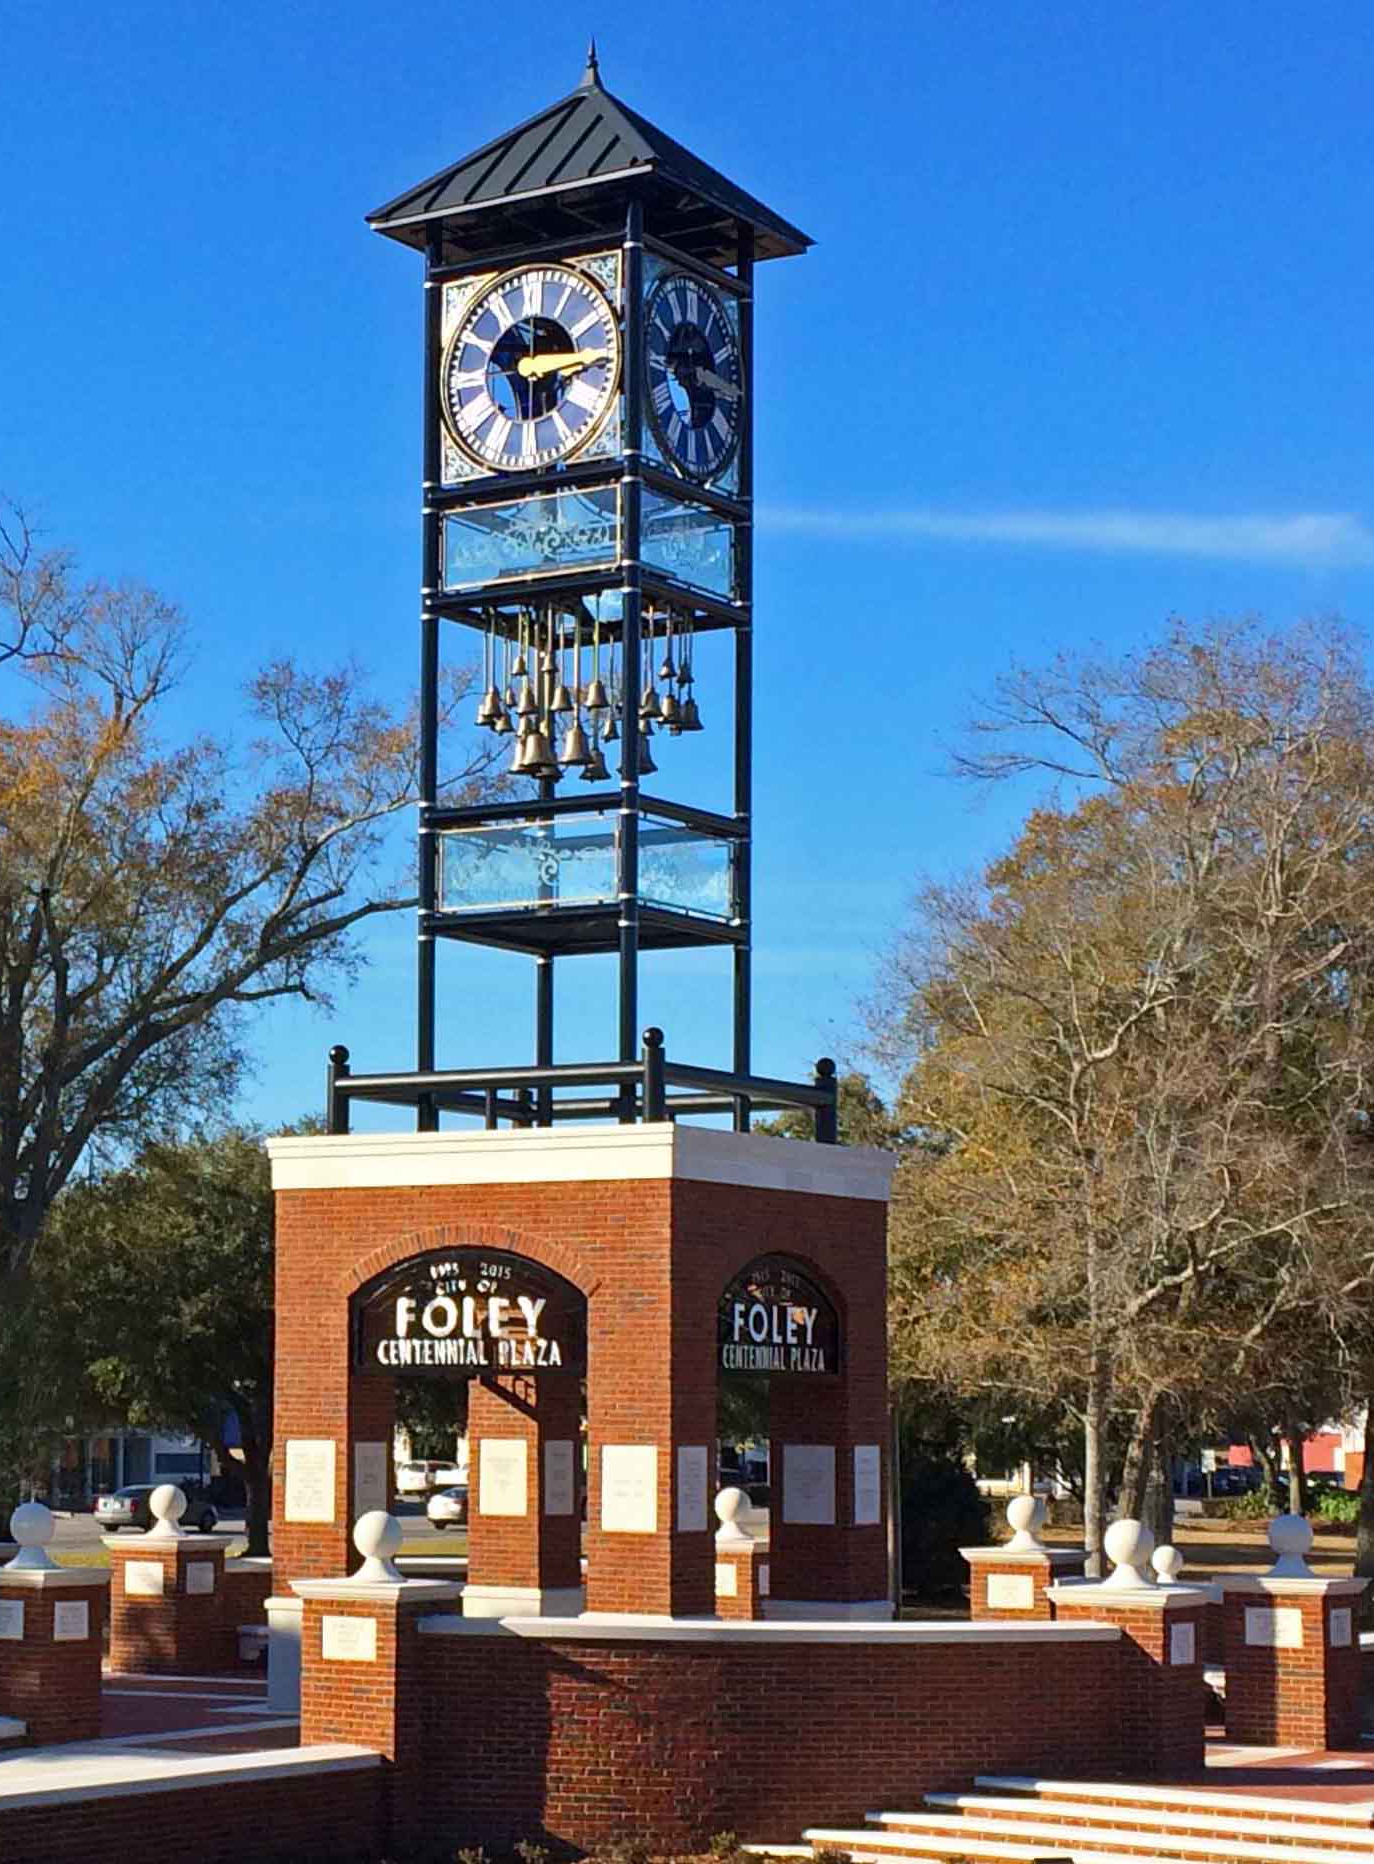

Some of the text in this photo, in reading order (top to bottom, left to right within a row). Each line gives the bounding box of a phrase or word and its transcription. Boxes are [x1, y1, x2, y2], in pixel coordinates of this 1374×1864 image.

[479, 1261, 513, 1280] 2015
[395, 1296, 546, 1338] FOLEY
[733, 1303, 818, 1344] FOLEY
[377, 1340, 562, 1366] CENTENNIAL PLAZA
[723, 1344, 826, 1371] CENTENNIAL PLAZA
